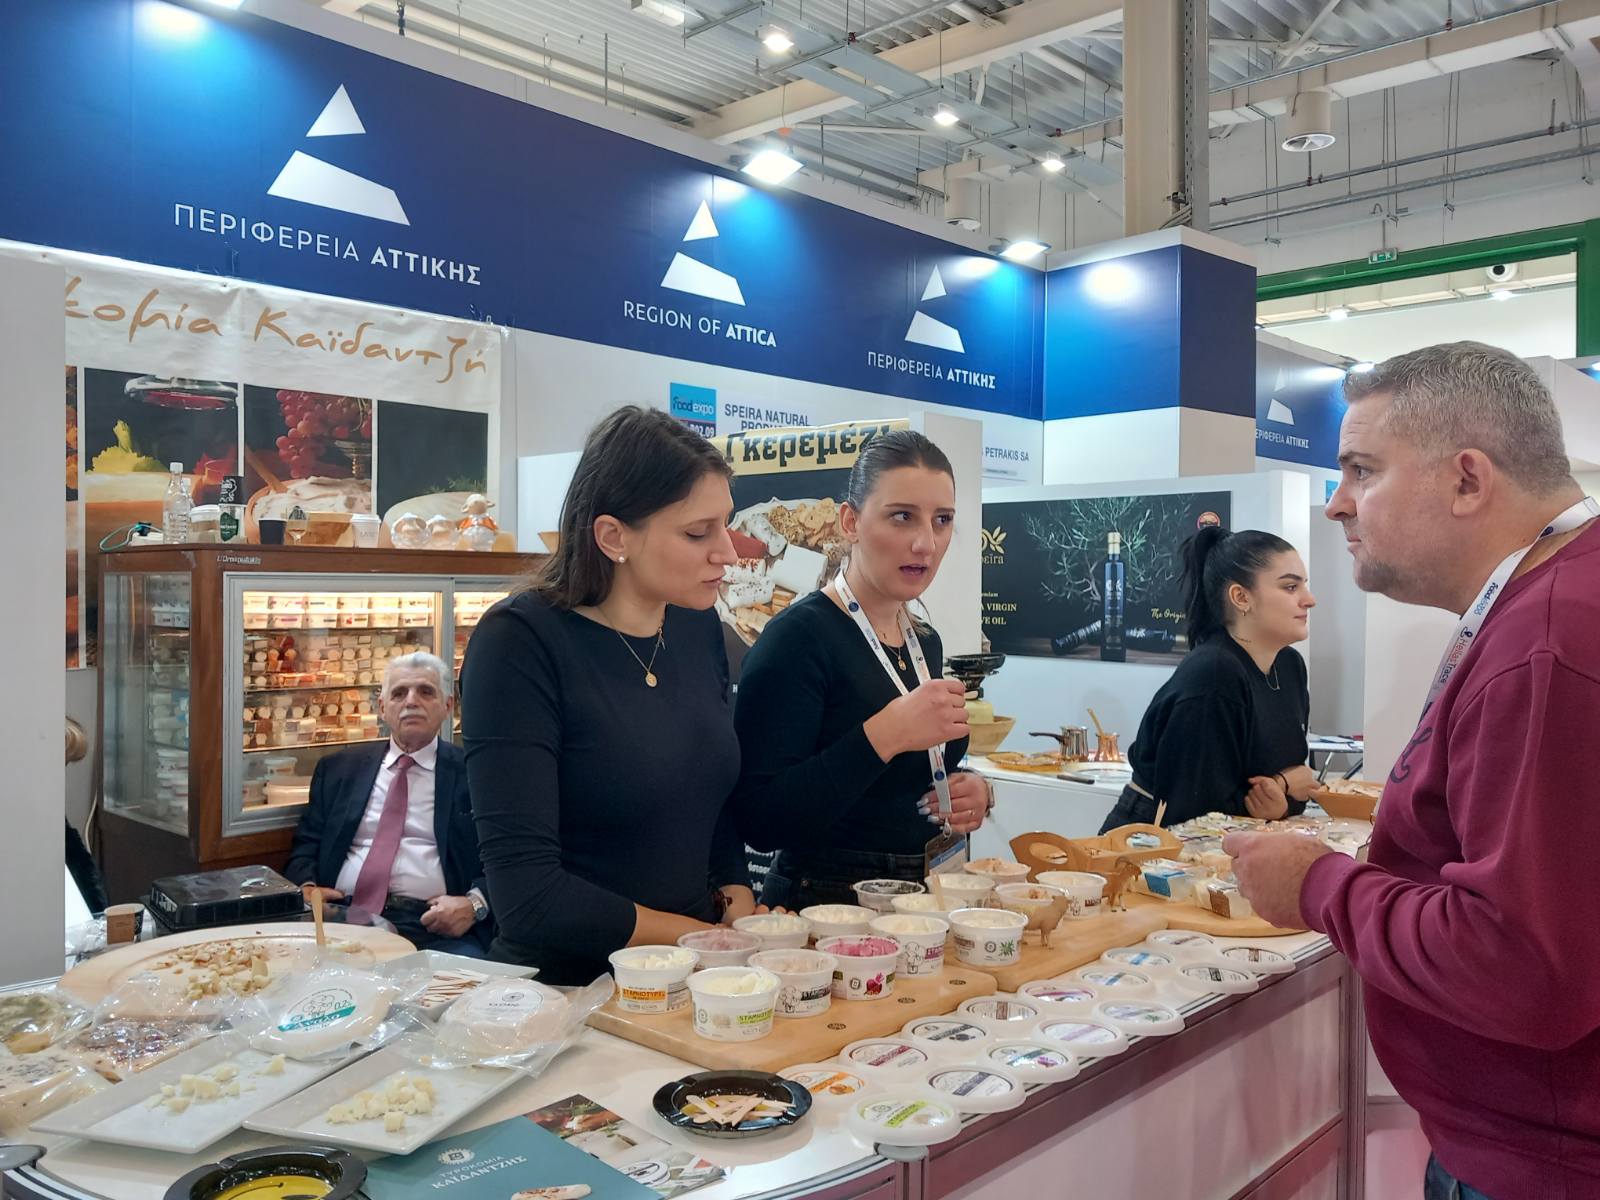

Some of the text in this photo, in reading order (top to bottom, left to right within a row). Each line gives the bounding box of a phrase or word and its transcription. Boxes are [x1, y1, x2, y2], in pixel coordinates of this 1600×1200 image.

[174, 203, 482, 286] ΠΕΡΙΦΕΡΕΙΑ ΑΤΤΙΚΗΣ
[624, 300, 777, 348] REGION OF ATTICA
[867, 351, 996, 390] ΠΕΡΙΦΕΡΕΙΑ ΑΤΤΙΚΗΣ
[724, 403, 811, 427] SPEIRA NATURAL
[985, 446, 1029, 461] PETRAKIS SA
[986, 603, 1017, 612] VIRGIN
[1151, 607, 1163, 619] The
[992, 617, 1007, 625] OIL
